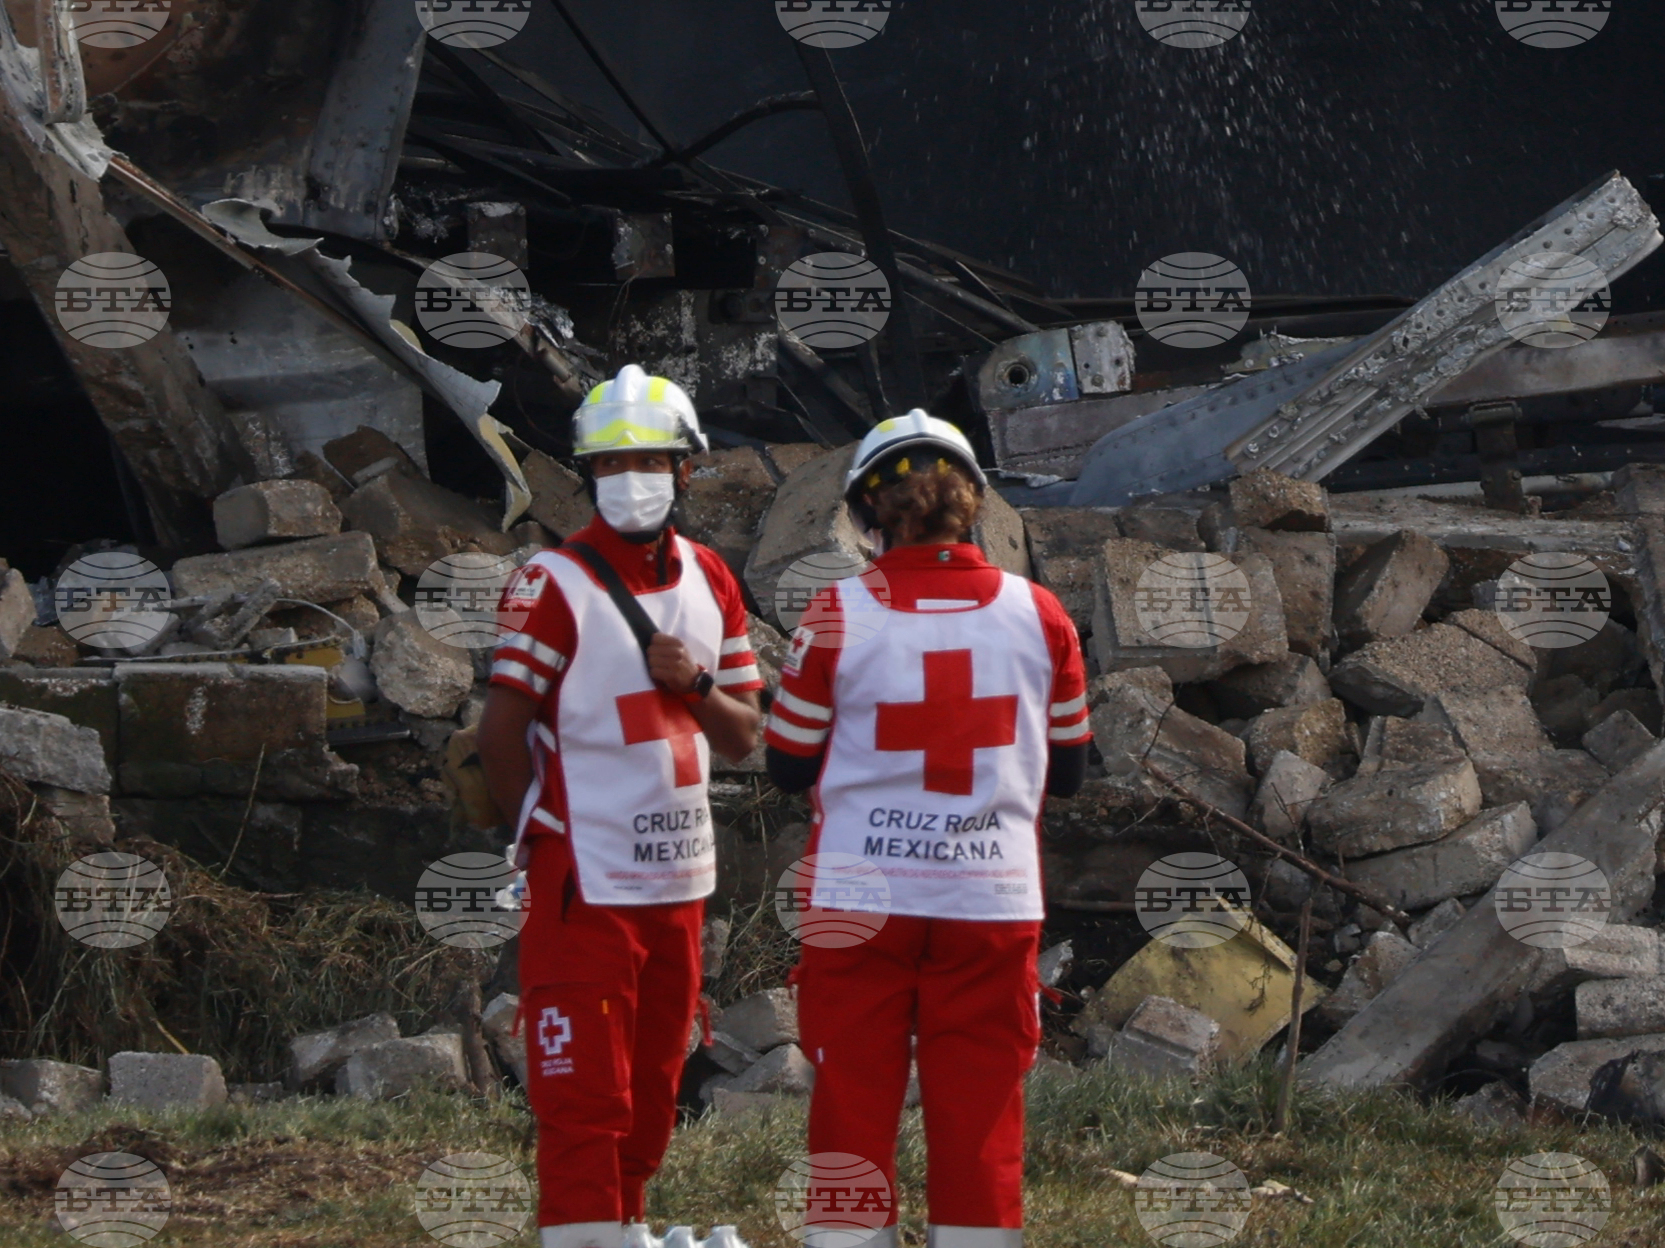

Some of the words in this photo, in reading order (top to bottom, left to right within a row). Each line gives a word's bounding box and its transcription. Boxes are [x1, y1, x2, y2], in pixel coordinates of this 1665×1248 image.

[633, 809, 691, 834] CRUZ
[868, 807, 939, 831] CRUZ
[944, 810, 1001, 833] ROJA
[864, 835, 1004, 861] MEXICANA
